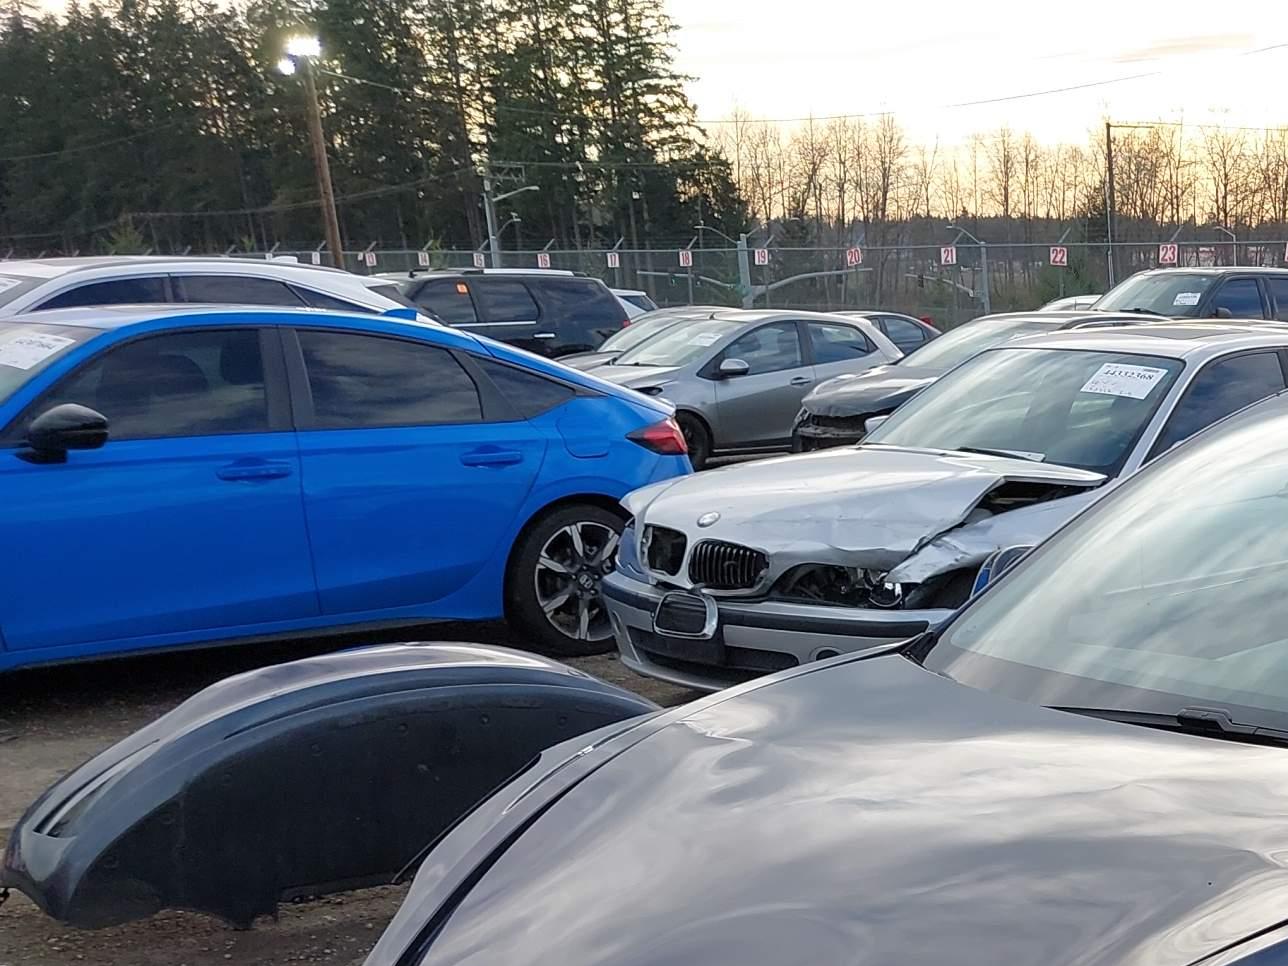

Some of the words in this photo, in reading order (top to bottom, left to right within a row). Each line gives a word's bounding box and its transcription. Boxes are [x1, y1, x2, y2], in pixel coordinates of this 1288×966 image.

[681, 251, 690, 265] 18
[757, 249, 766, 264] 19
[847, 249, 860, 265] 20
[943, 248, 954, 263] 21
[1052, 248, 1065, 264] 22
[1160, 245, 1176, 262] 23
